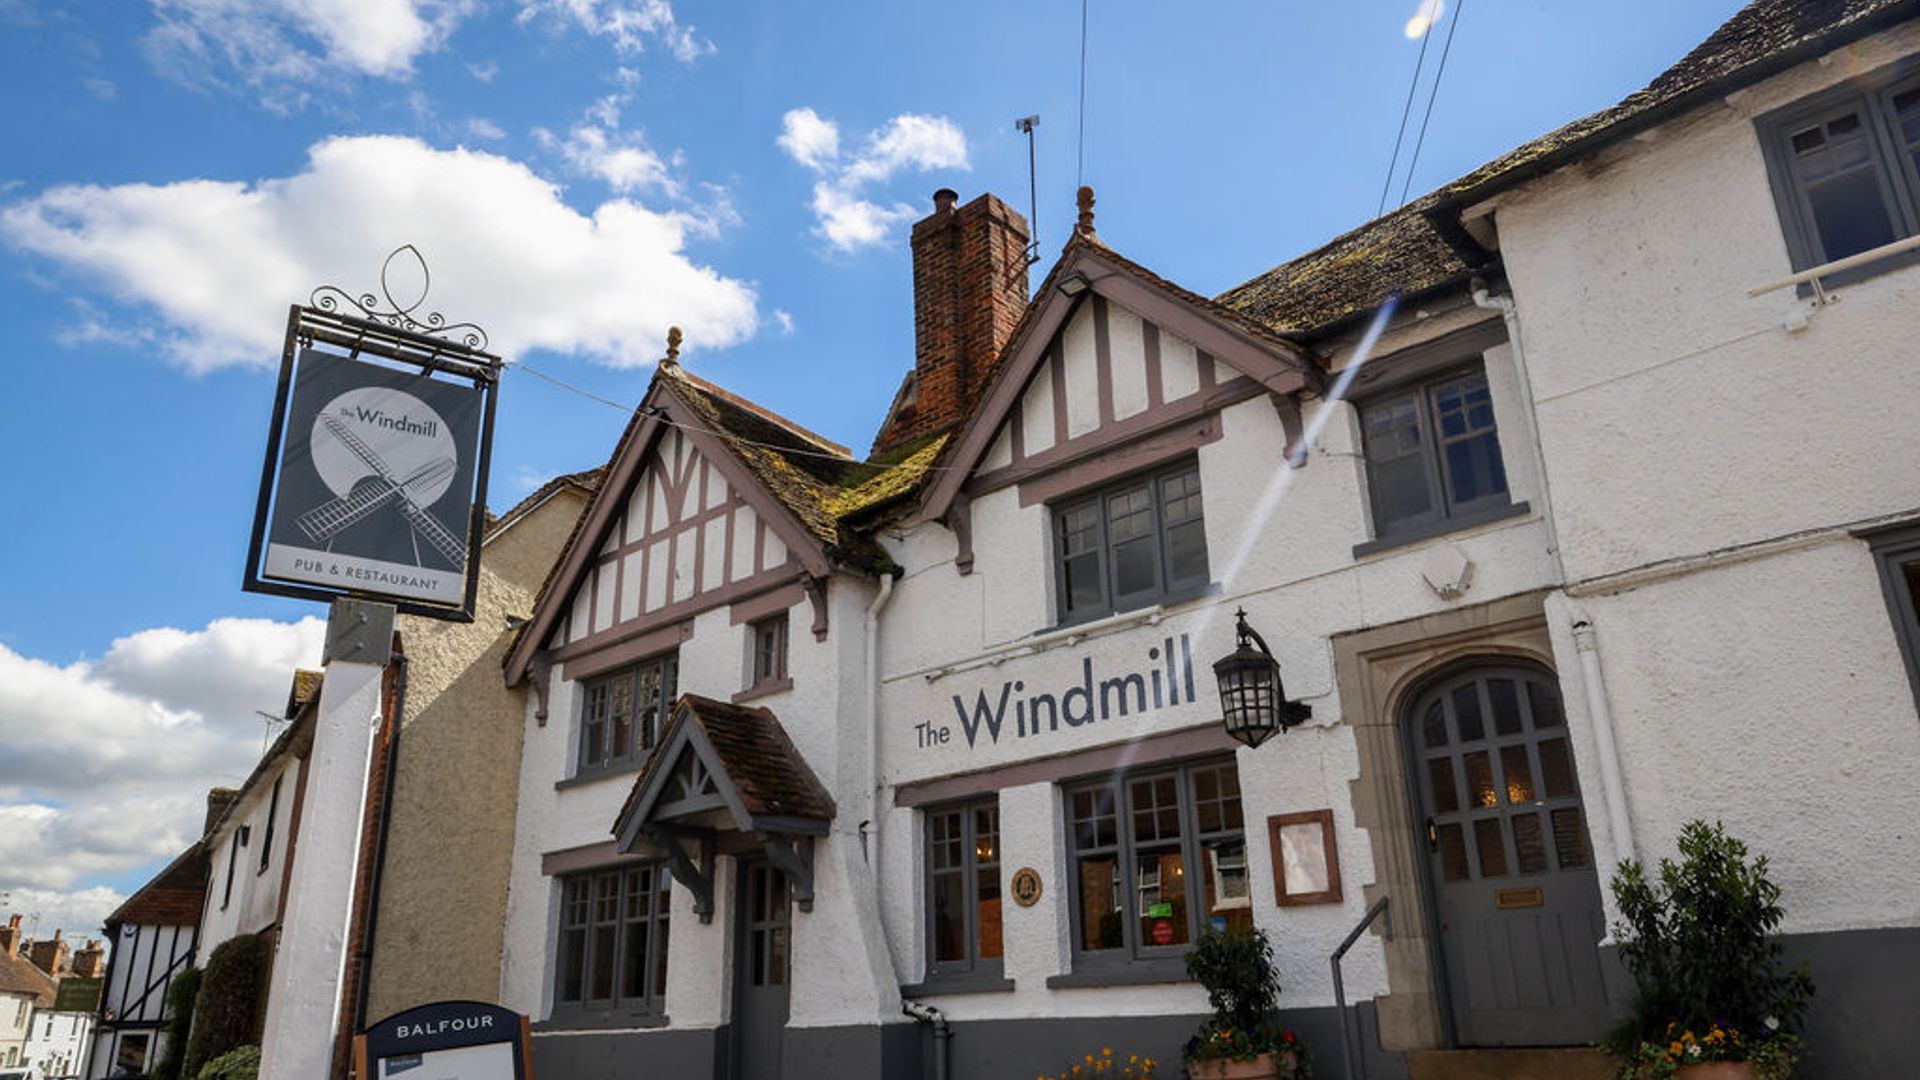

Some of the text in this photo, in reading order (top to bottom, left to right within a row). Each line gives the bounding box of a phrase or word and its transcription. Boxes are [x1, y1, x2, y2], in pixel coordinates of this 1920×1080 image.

[356, 405, 437, 438] Windmill
[294, 558, 438, 590] PUB & RESTAURANT
[915, 633, 1196, 749] The Windmill
[397, 1015, 493, 1038] BALFOUR
